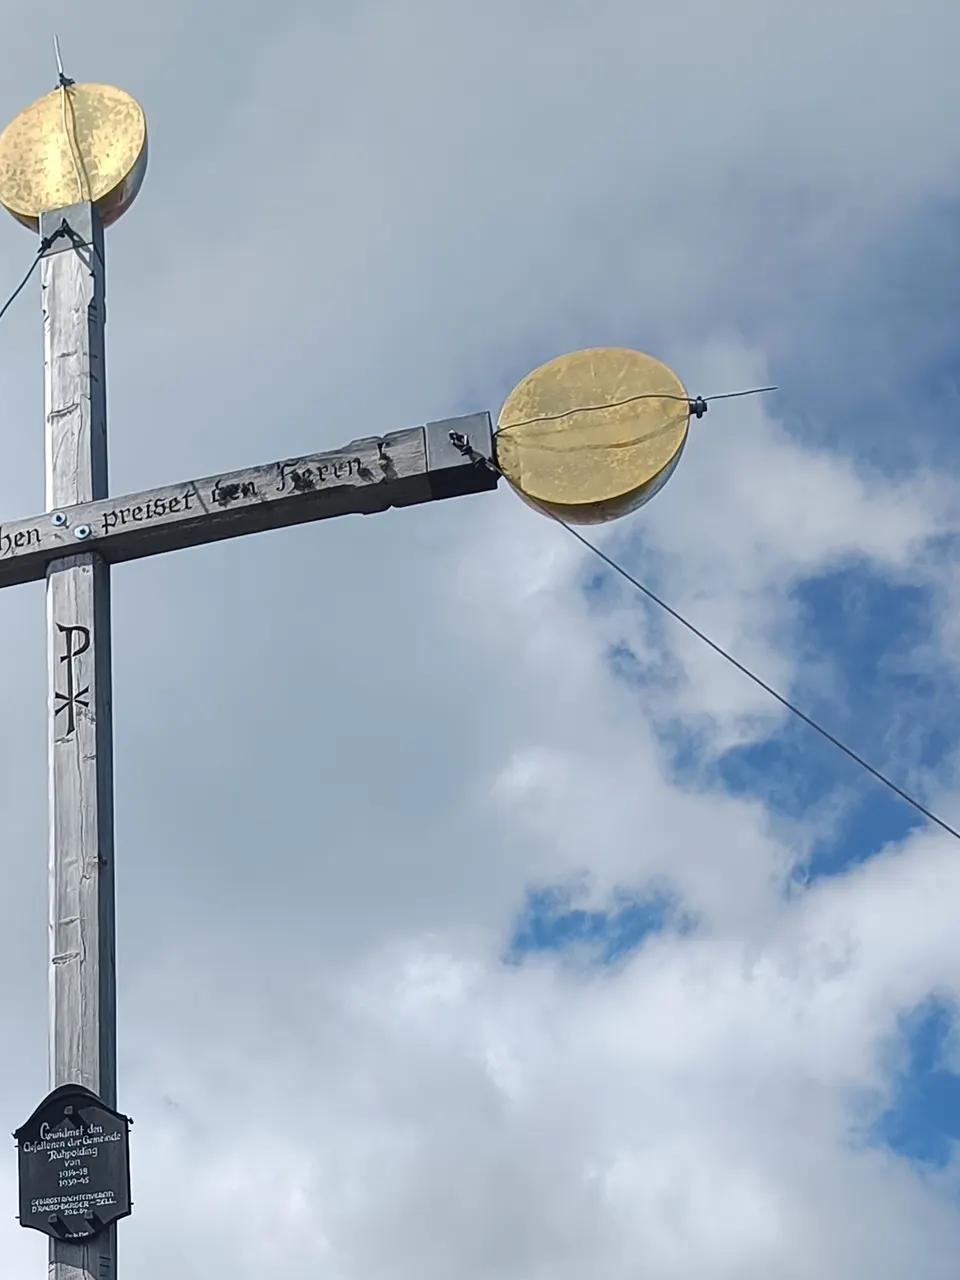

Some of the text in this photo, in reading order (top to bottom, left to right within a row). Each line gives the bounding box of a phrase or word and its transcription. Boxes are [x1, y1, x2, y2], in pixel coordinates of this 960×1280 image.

[101, 489, 197, 535] preiset
[210, 479, 258, 508] den
[47, 1146, 98, 1162] Ruhpolding
[64, 1158, 81, 1167] von
